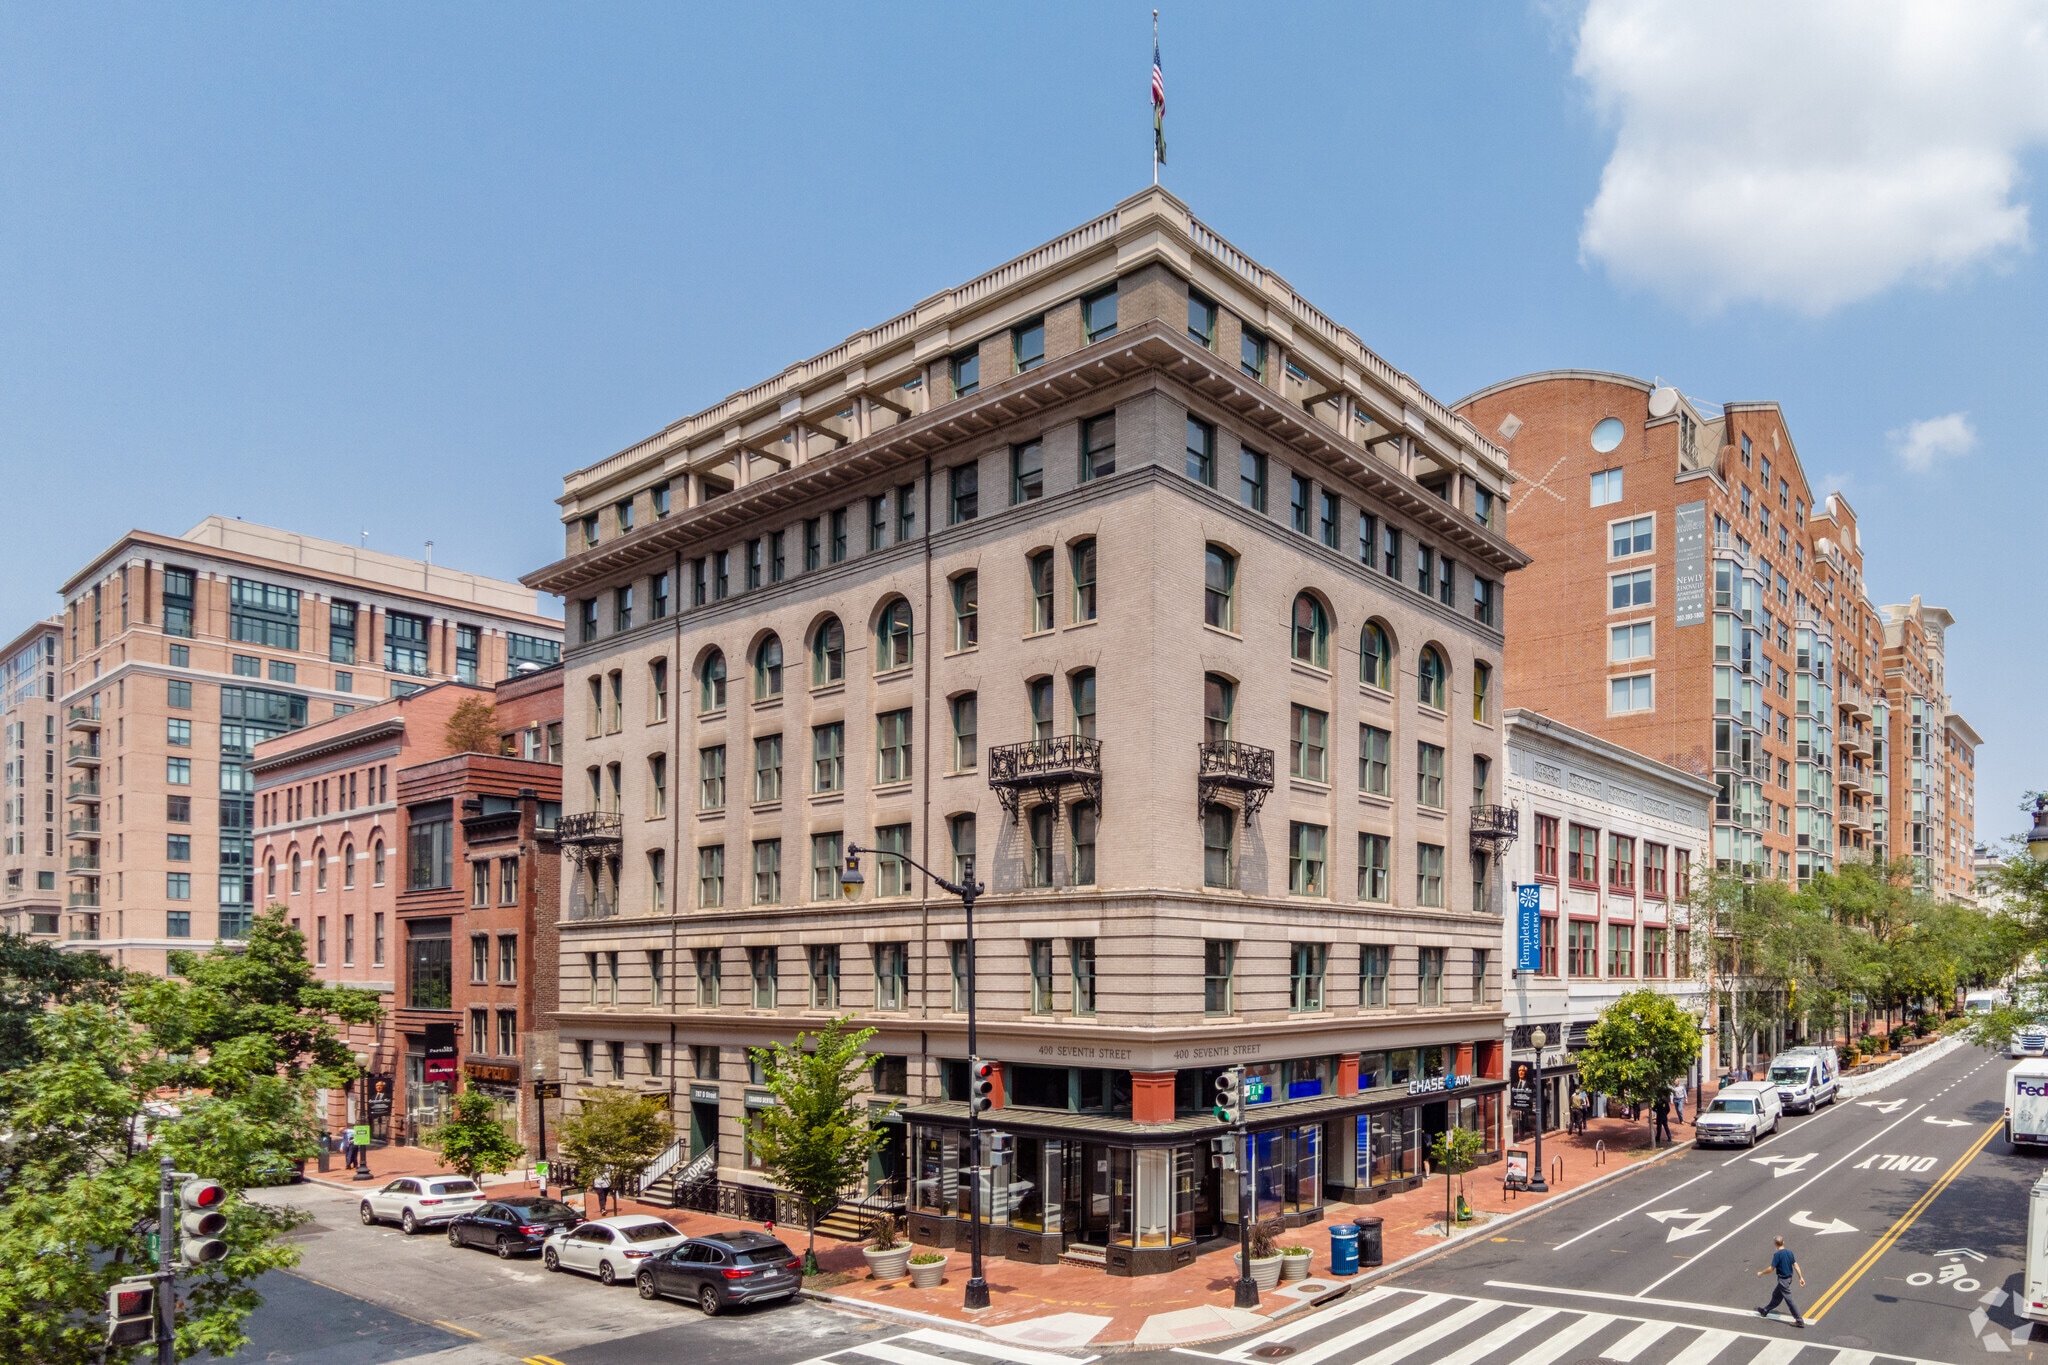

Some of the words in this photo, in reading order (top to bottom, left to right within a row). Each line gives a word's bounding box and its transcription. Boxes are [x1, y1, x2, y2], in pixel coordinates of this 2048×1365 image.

[1676, 574, 1703, 584] NEWLY
[1677, 594, 1703, 602] AVAILABLE
[1520, 912, 1532, 968] Templeton
[1038, 1045, 1053, 1055] 400
[1057, 1046, 1095, 1058] SEVENTH
[1099, 1048, 1132, 1060] STREET
[1173, 1049, 1189, 1060] 400
[1193, 1046, 1229, 1058] SEVENTH
[1233, 1044, 1261, 1056] STREET
[1409, 1076, 1444, 1094] CHASE
[1455, 1074, 1471, 1086] ATM
[2017, 1081, 2048, 1096] Fed
[687, 1154, 714, 1177] OPEN
[1852, 1154, 1938, 1172] ONLY
